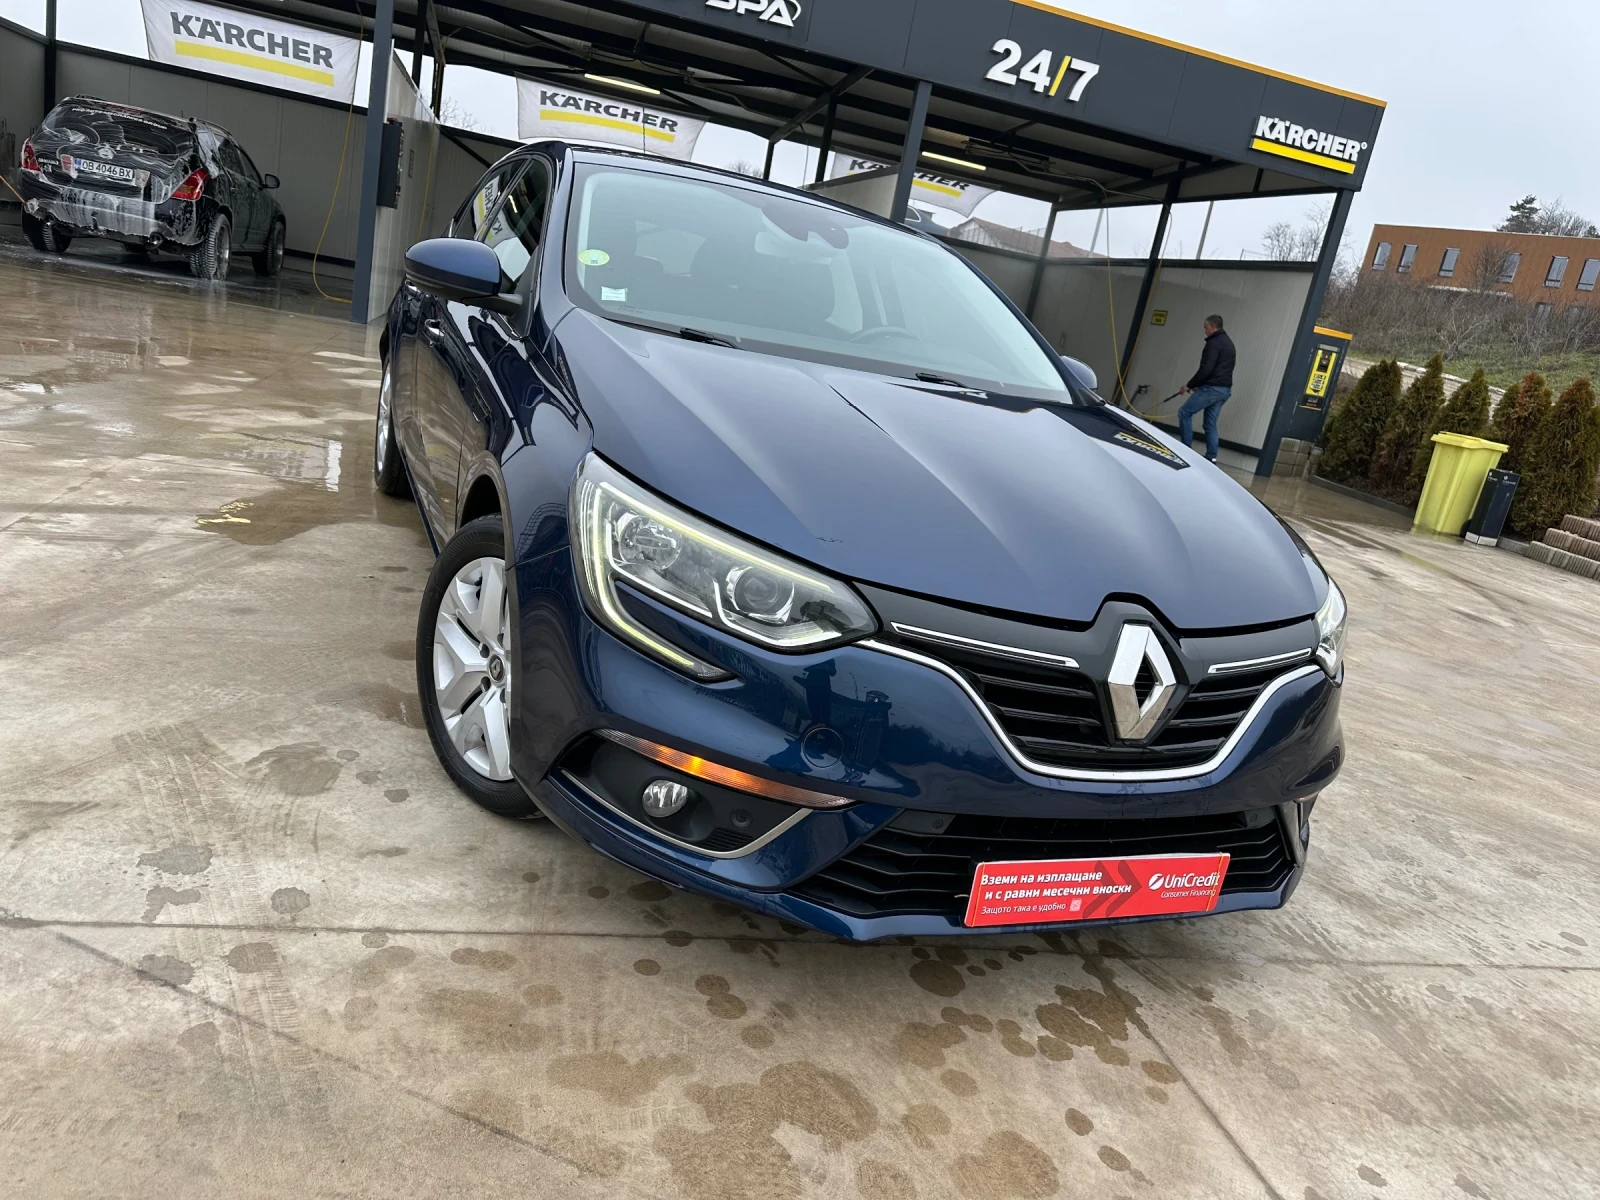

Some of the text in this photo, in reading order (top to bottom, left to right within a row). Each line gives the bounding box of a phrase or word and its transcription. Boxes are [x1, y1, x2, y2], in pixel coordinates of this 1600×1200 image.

[169, 11, 334, 69] KÄRCHER
[985, 38, 1100, 102] 24/7
[540, 90, 679, 132] KÄRCHER
[96, 162, 118, 176] 4046
[119, 168, 131, 180] BX
[981, 871, 1103, 886] Вземи на изплащане
[1164, 872, 1220, 888] UniCredit
[985, 884, 1132, 901] и с равни месечни вноски
[981, 905, 1011, 915] Защото
[1014, 904, 1031, 912] така
[1038, 902, 1067, 912] удобно
